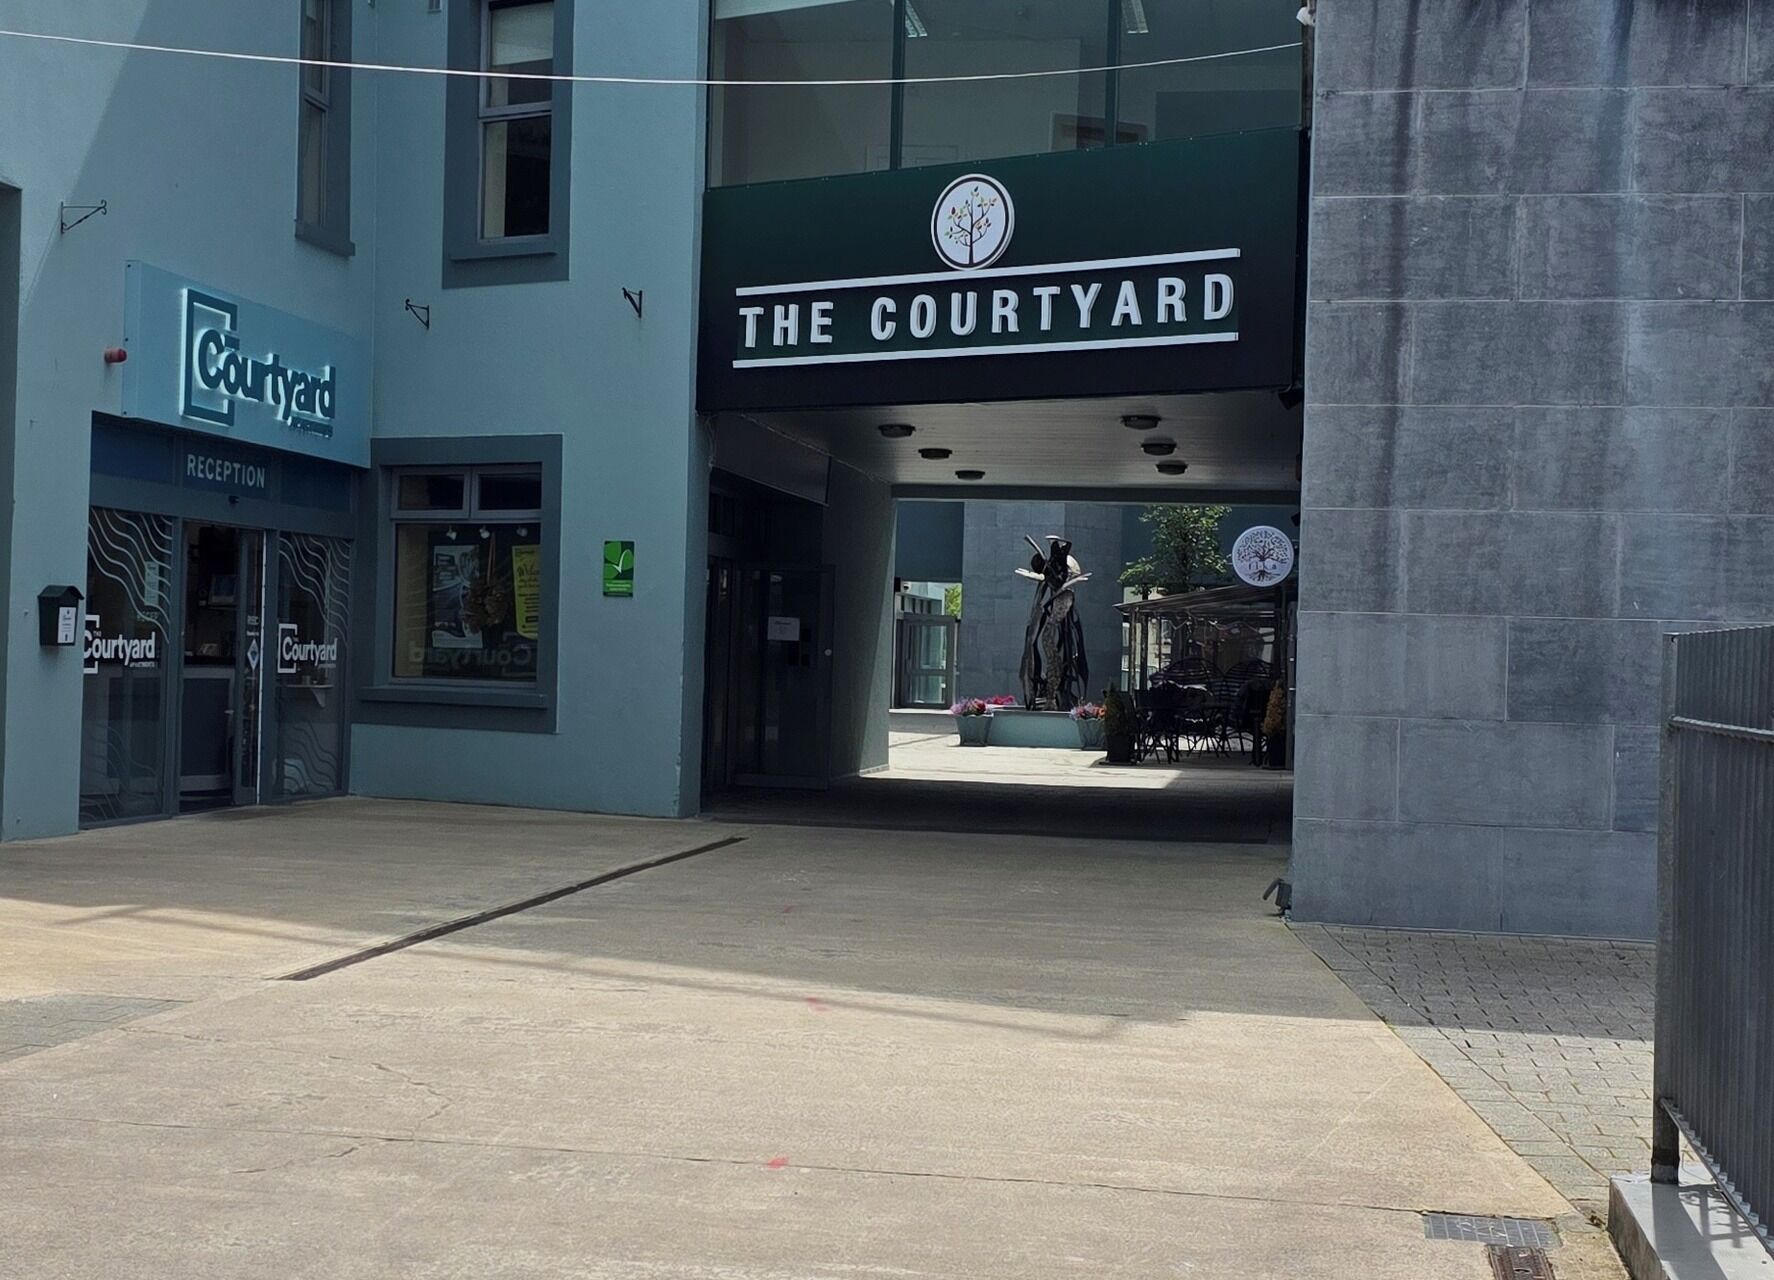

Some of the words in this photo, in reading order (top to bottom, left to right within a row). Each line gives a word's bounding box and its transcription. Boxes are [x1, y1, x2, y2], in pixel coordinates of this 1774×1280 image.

[738, 300, 835, 349] THE
[870, 272, 1235, 342] COURTYARD
[197, 328, 337, 421] Courtyard
[187, 453, 265, 489] RECEPTION
[84, 629, 156, 666] Courtyard
[282, 636, 338, 667] Courtyard
